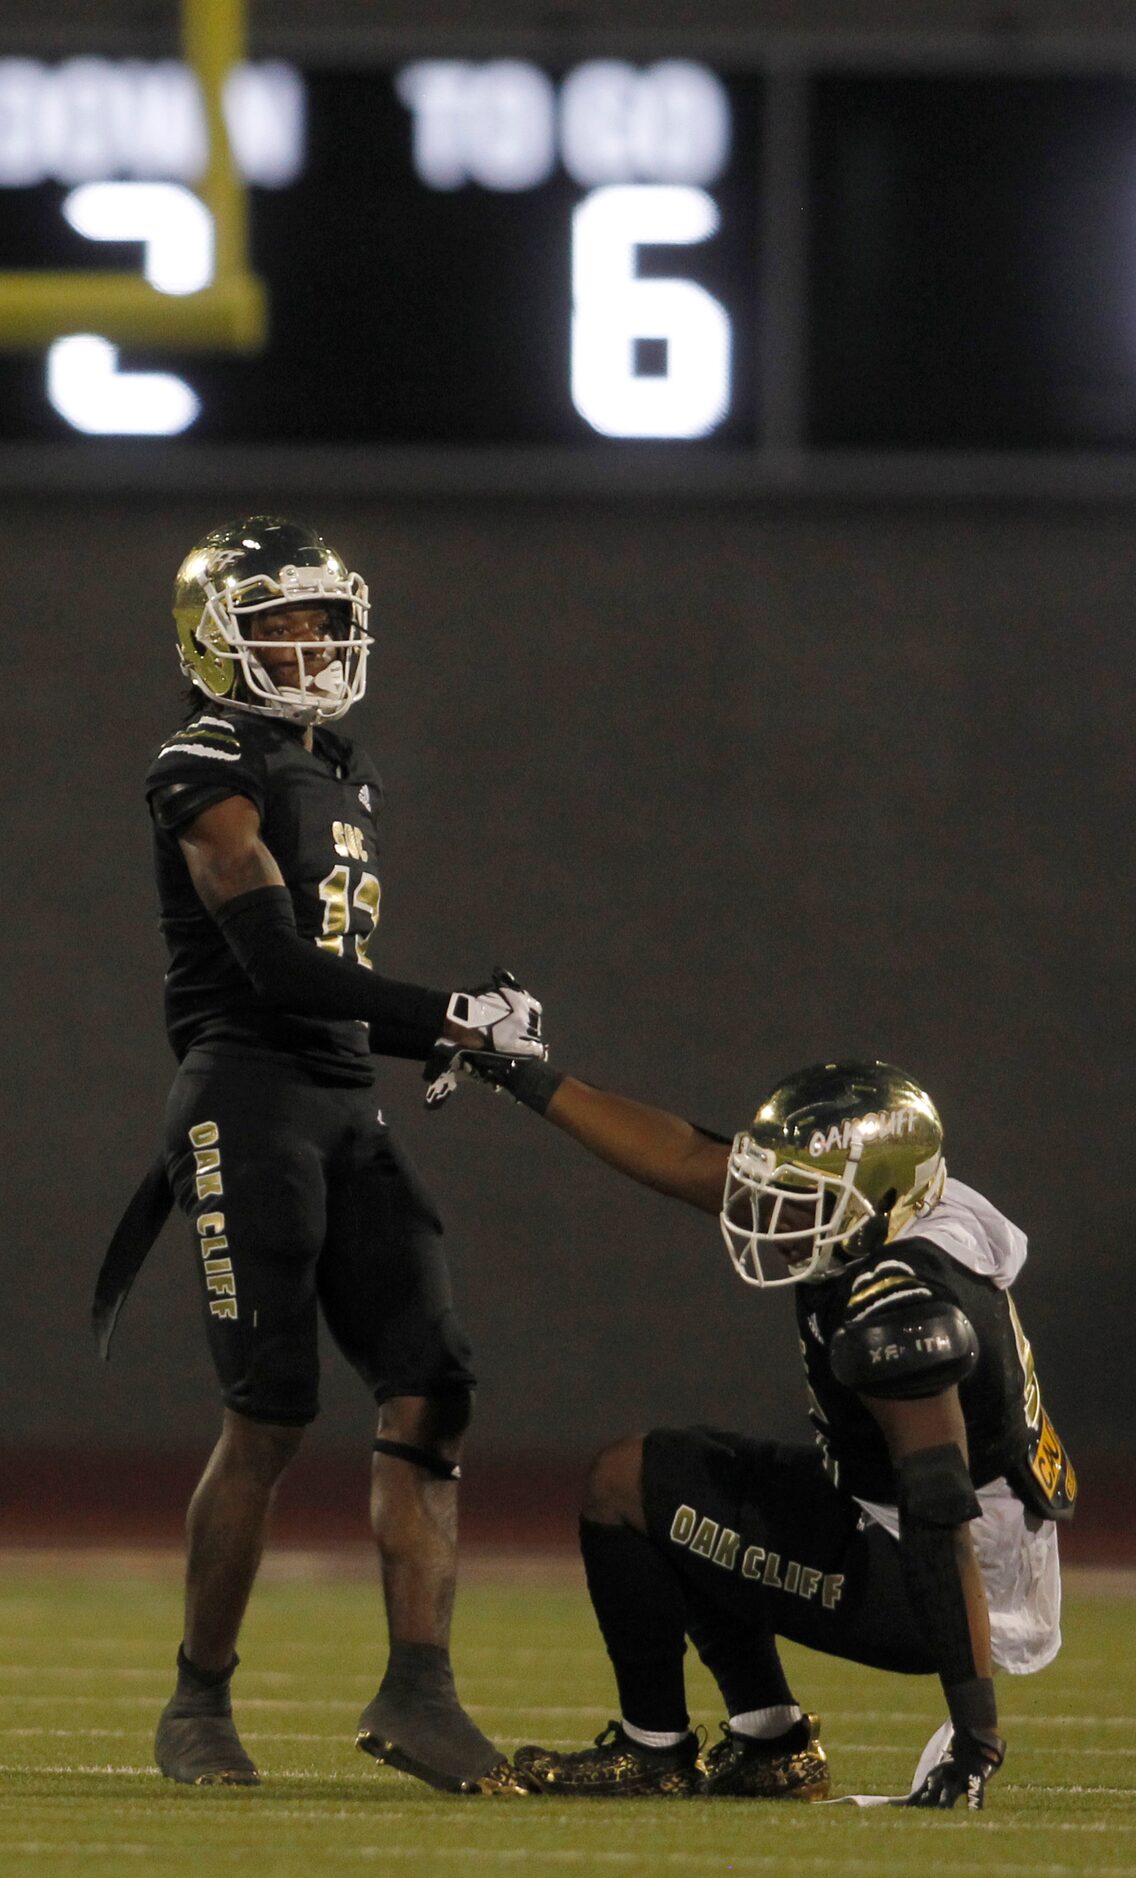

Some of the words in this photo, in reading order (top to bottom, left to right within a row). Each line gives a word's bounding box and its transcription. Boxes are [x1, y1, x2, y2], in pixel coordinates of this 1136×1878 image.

[398, 60, 557, 190] TO
[562, 60, 729, 188] GO
[571, 184, 732, 438] 6
[188, 1120, 224, 1200] OAK
[196, 1211, 239, 1320] CLIFF
[669, 1503, 741, 1570] OAK
[741, 1545, 845, 1610] CLIFF
